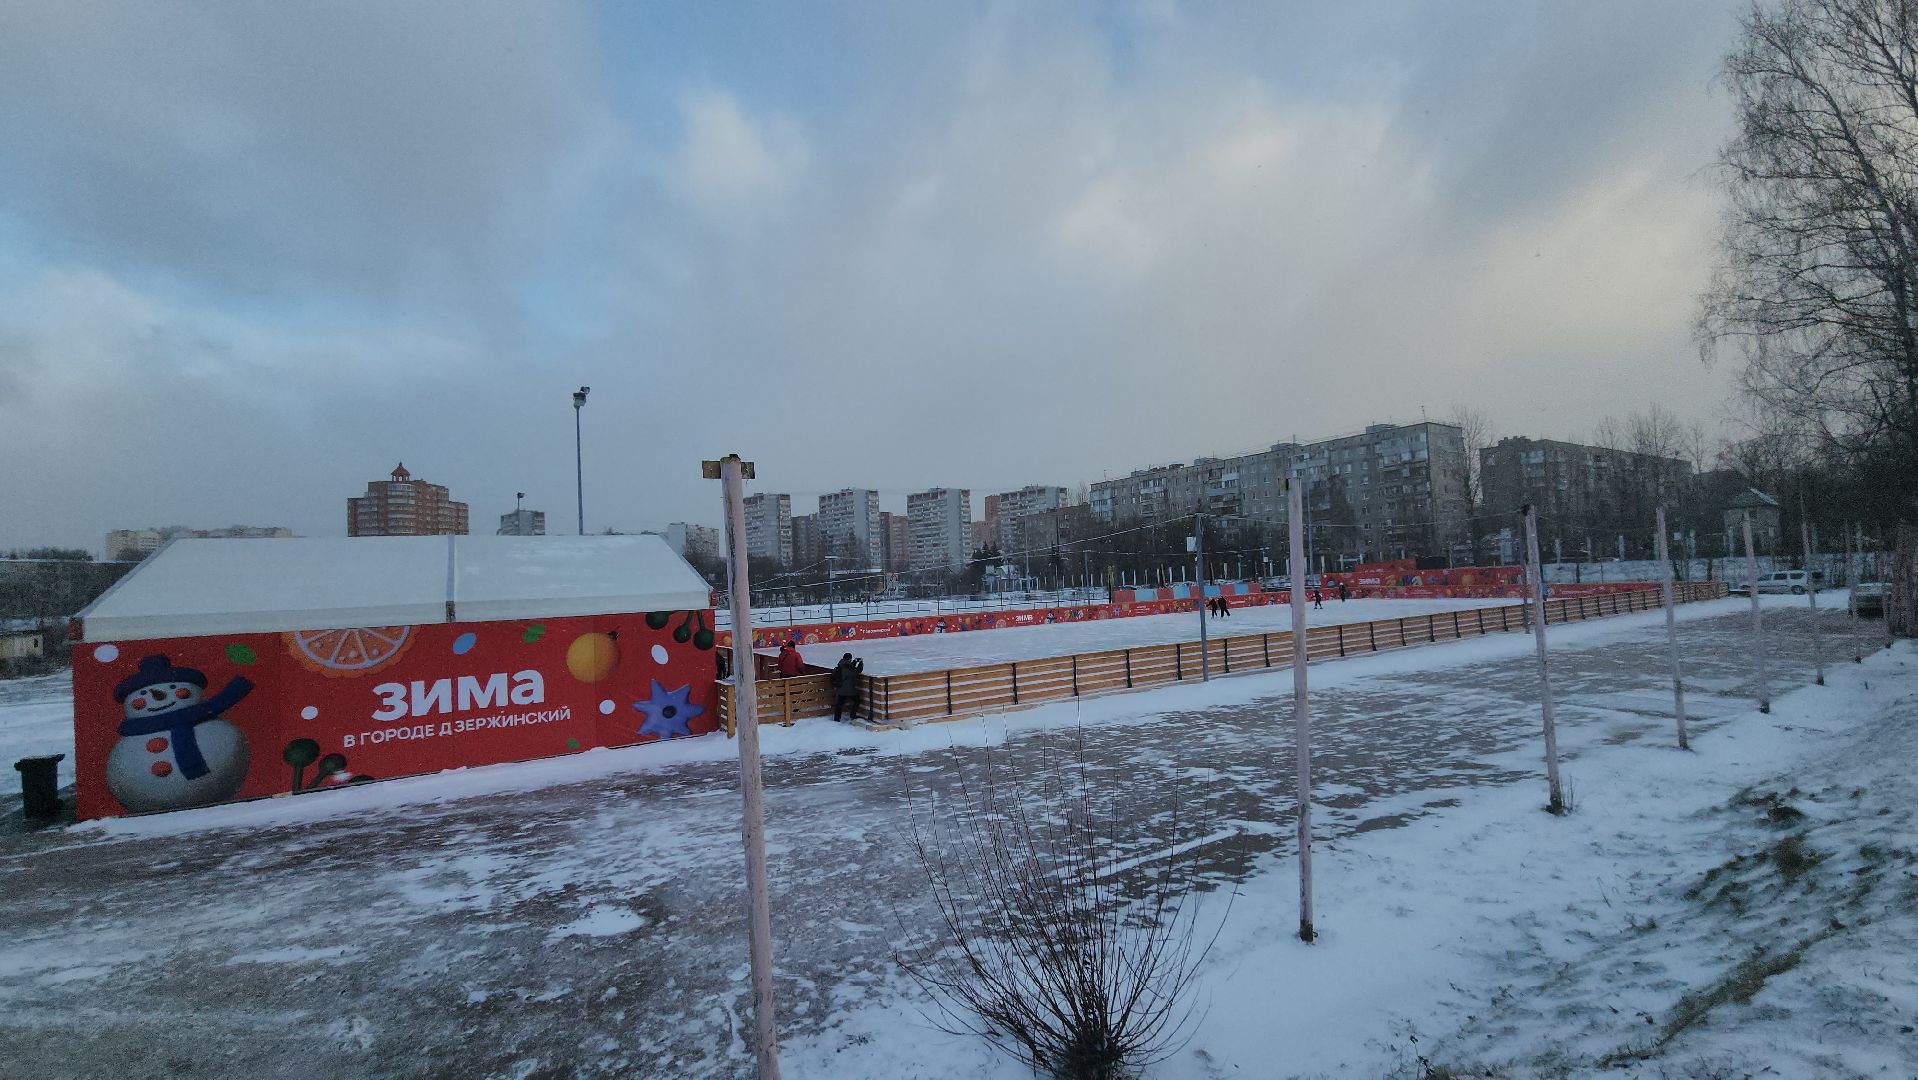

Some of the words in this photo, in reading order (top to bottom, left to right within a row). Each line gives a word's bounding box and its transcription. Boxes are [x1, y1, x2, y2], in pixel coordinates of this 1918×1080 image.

[343, 734, 356, 748] В
[360, 724, 435, 745] ГОРОДЕ
[438, 705, 571, 736] ДЗЕРЖИНСКИЙ
